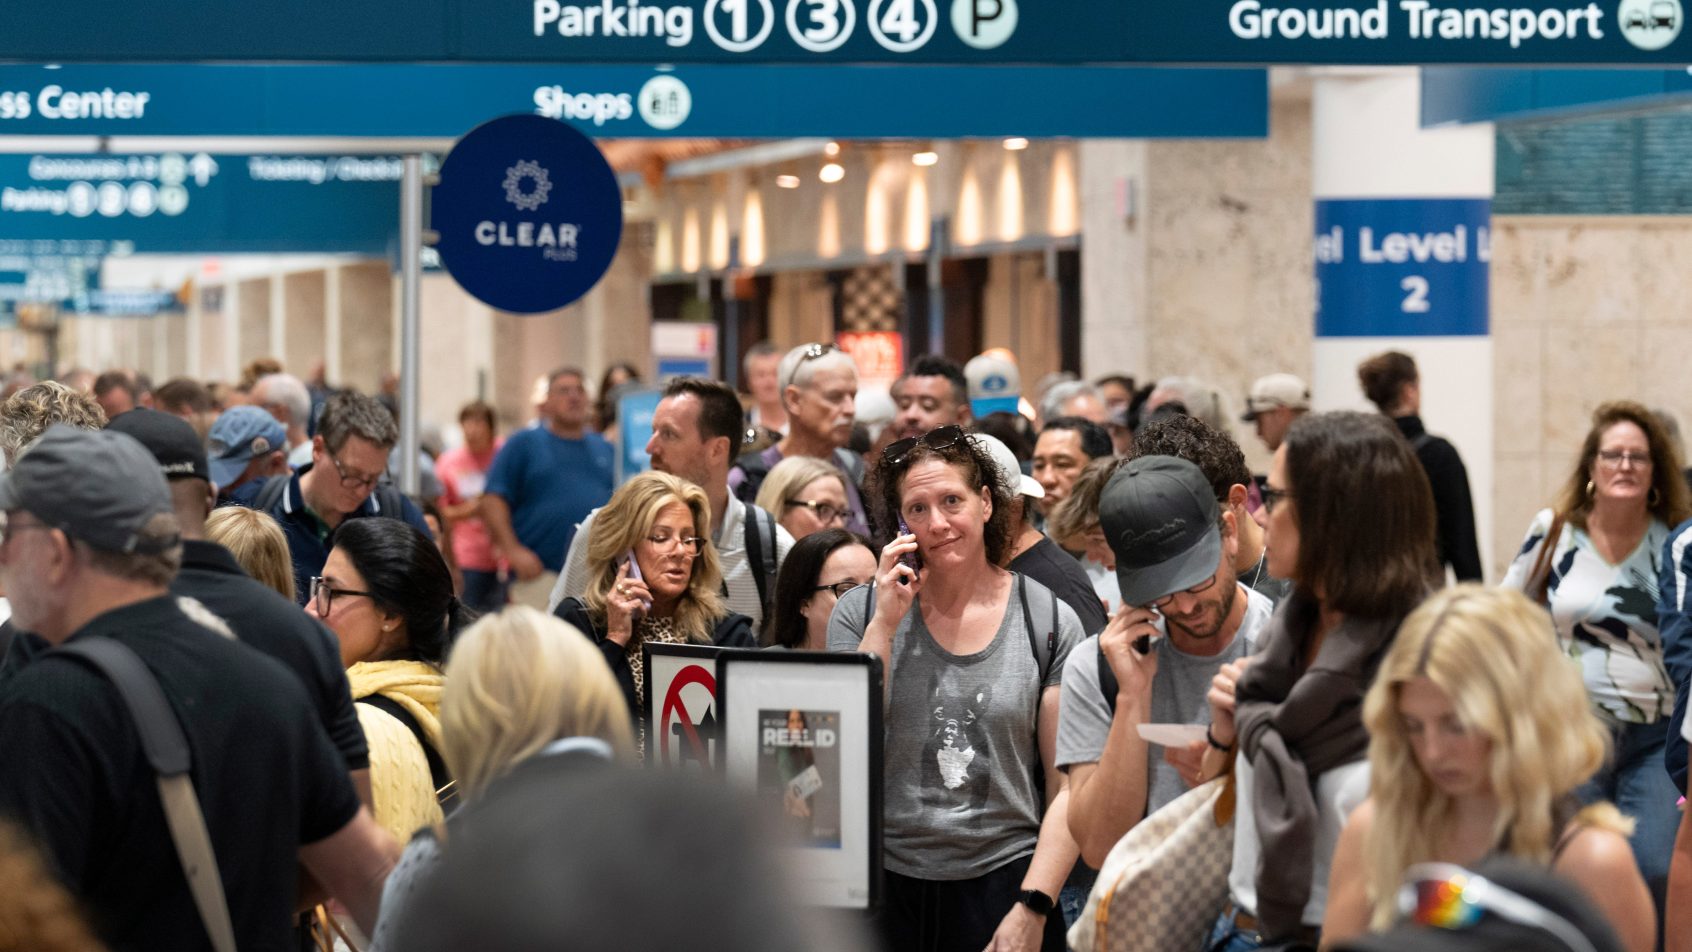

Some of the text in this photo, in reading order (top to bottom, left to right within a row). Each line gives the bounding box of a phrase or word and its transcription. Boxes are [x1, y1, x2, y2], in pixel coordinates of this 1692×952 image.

[533, 0, 694, 47] Parking
[1228, 0, 1605, 48] Ground Transport
[37, 84, 151, 119] Center
[533, 85, 633, 126] Shops
[474, 220, 579, 248] CLEAR
[1359, 224, 1467, 263] Level
[1401, 275, 1430, 313] 2
[763, 727, 836, 748] REAL ID
